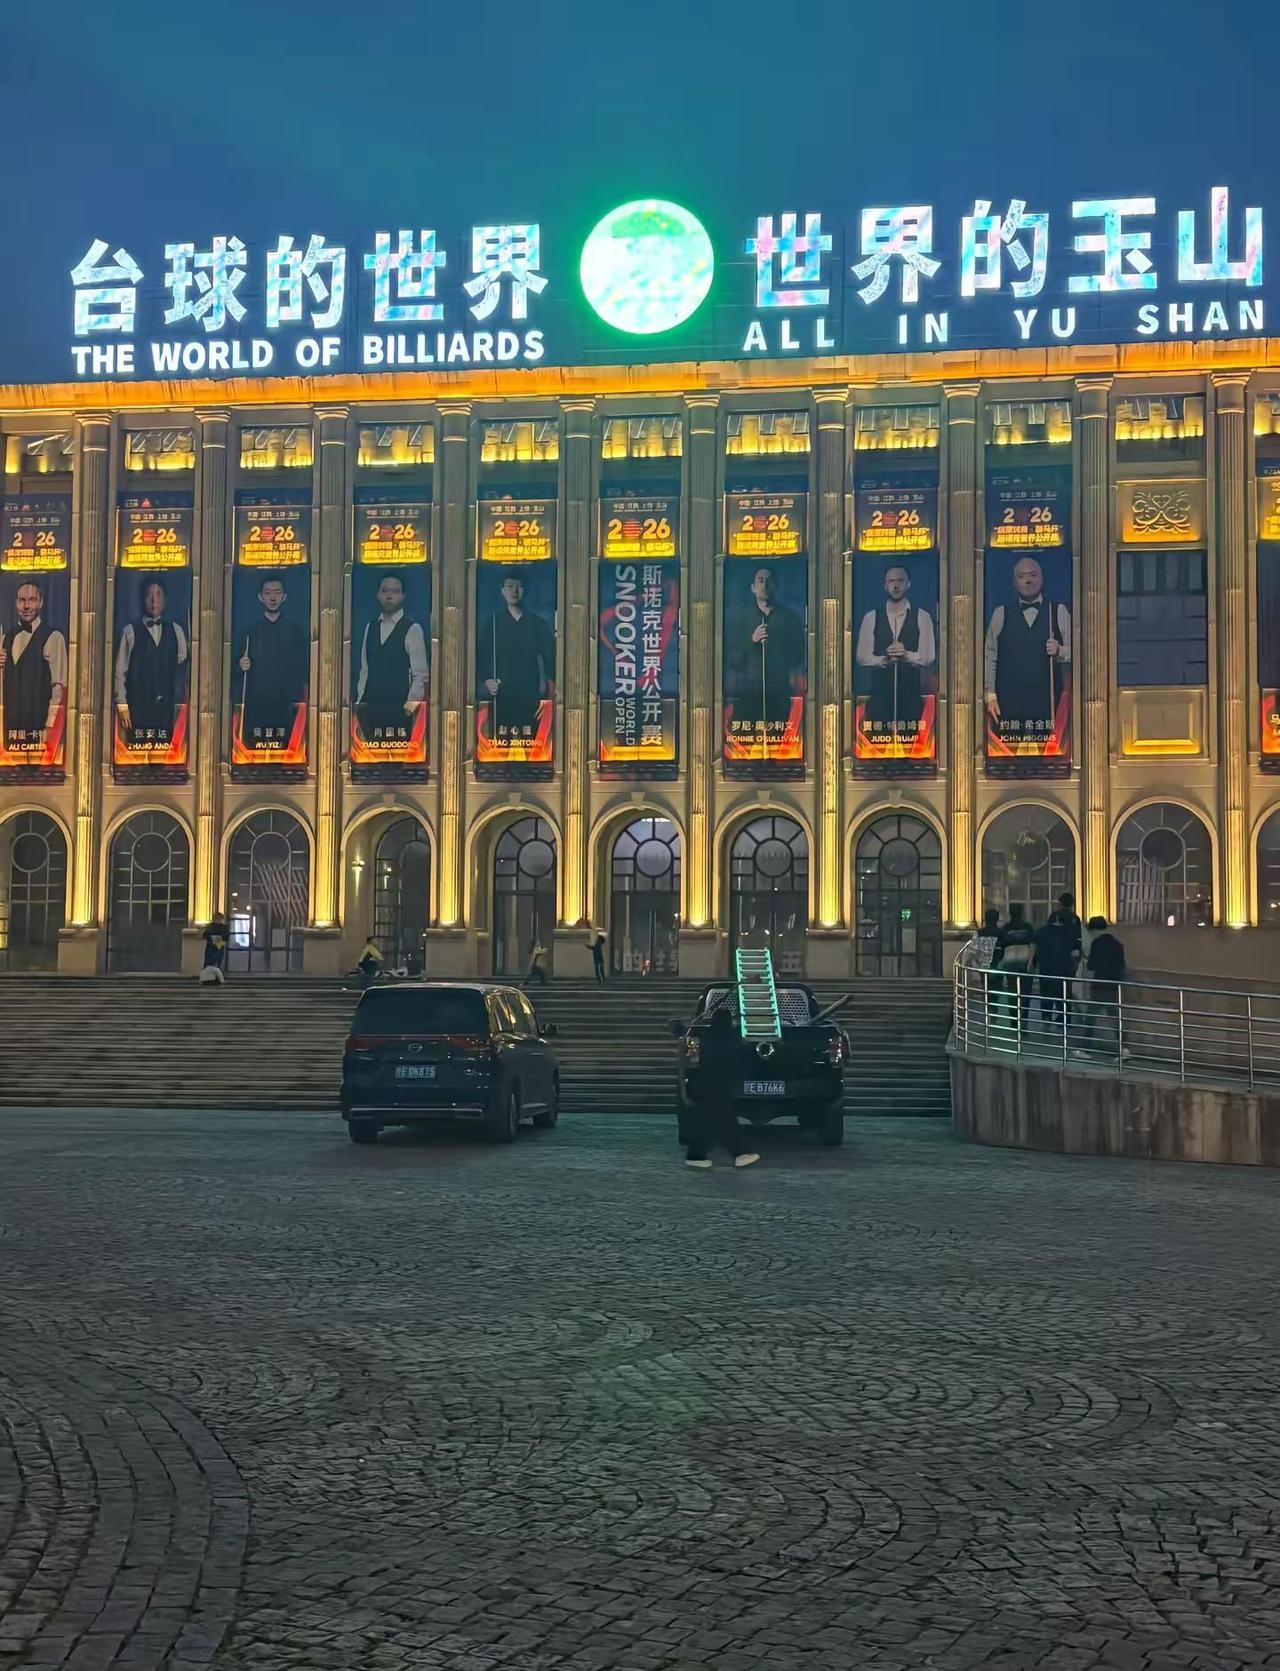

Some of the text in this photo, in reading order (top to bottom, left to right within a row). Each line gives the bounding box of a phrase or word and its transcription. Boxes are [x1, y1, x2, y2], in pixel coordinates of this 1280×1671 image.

[744, 186, 1263, 308] 世界的玉山
[70, 223, 549, 335] 台球的世界
[742, 299, 1265, 352] ALL IN YU SHAN
[71, 330, 545, 375] THE WORLD OF BILLIARDS
[615, 565, 637, 696] SNOOKER
[641, 564, 663, 746] 斯诺克世界公开赛
[615, 697, 625, 734] OPEN
[625, 697, 636, 746] WORLD
[727, 735, 754, 743] RONNIE
